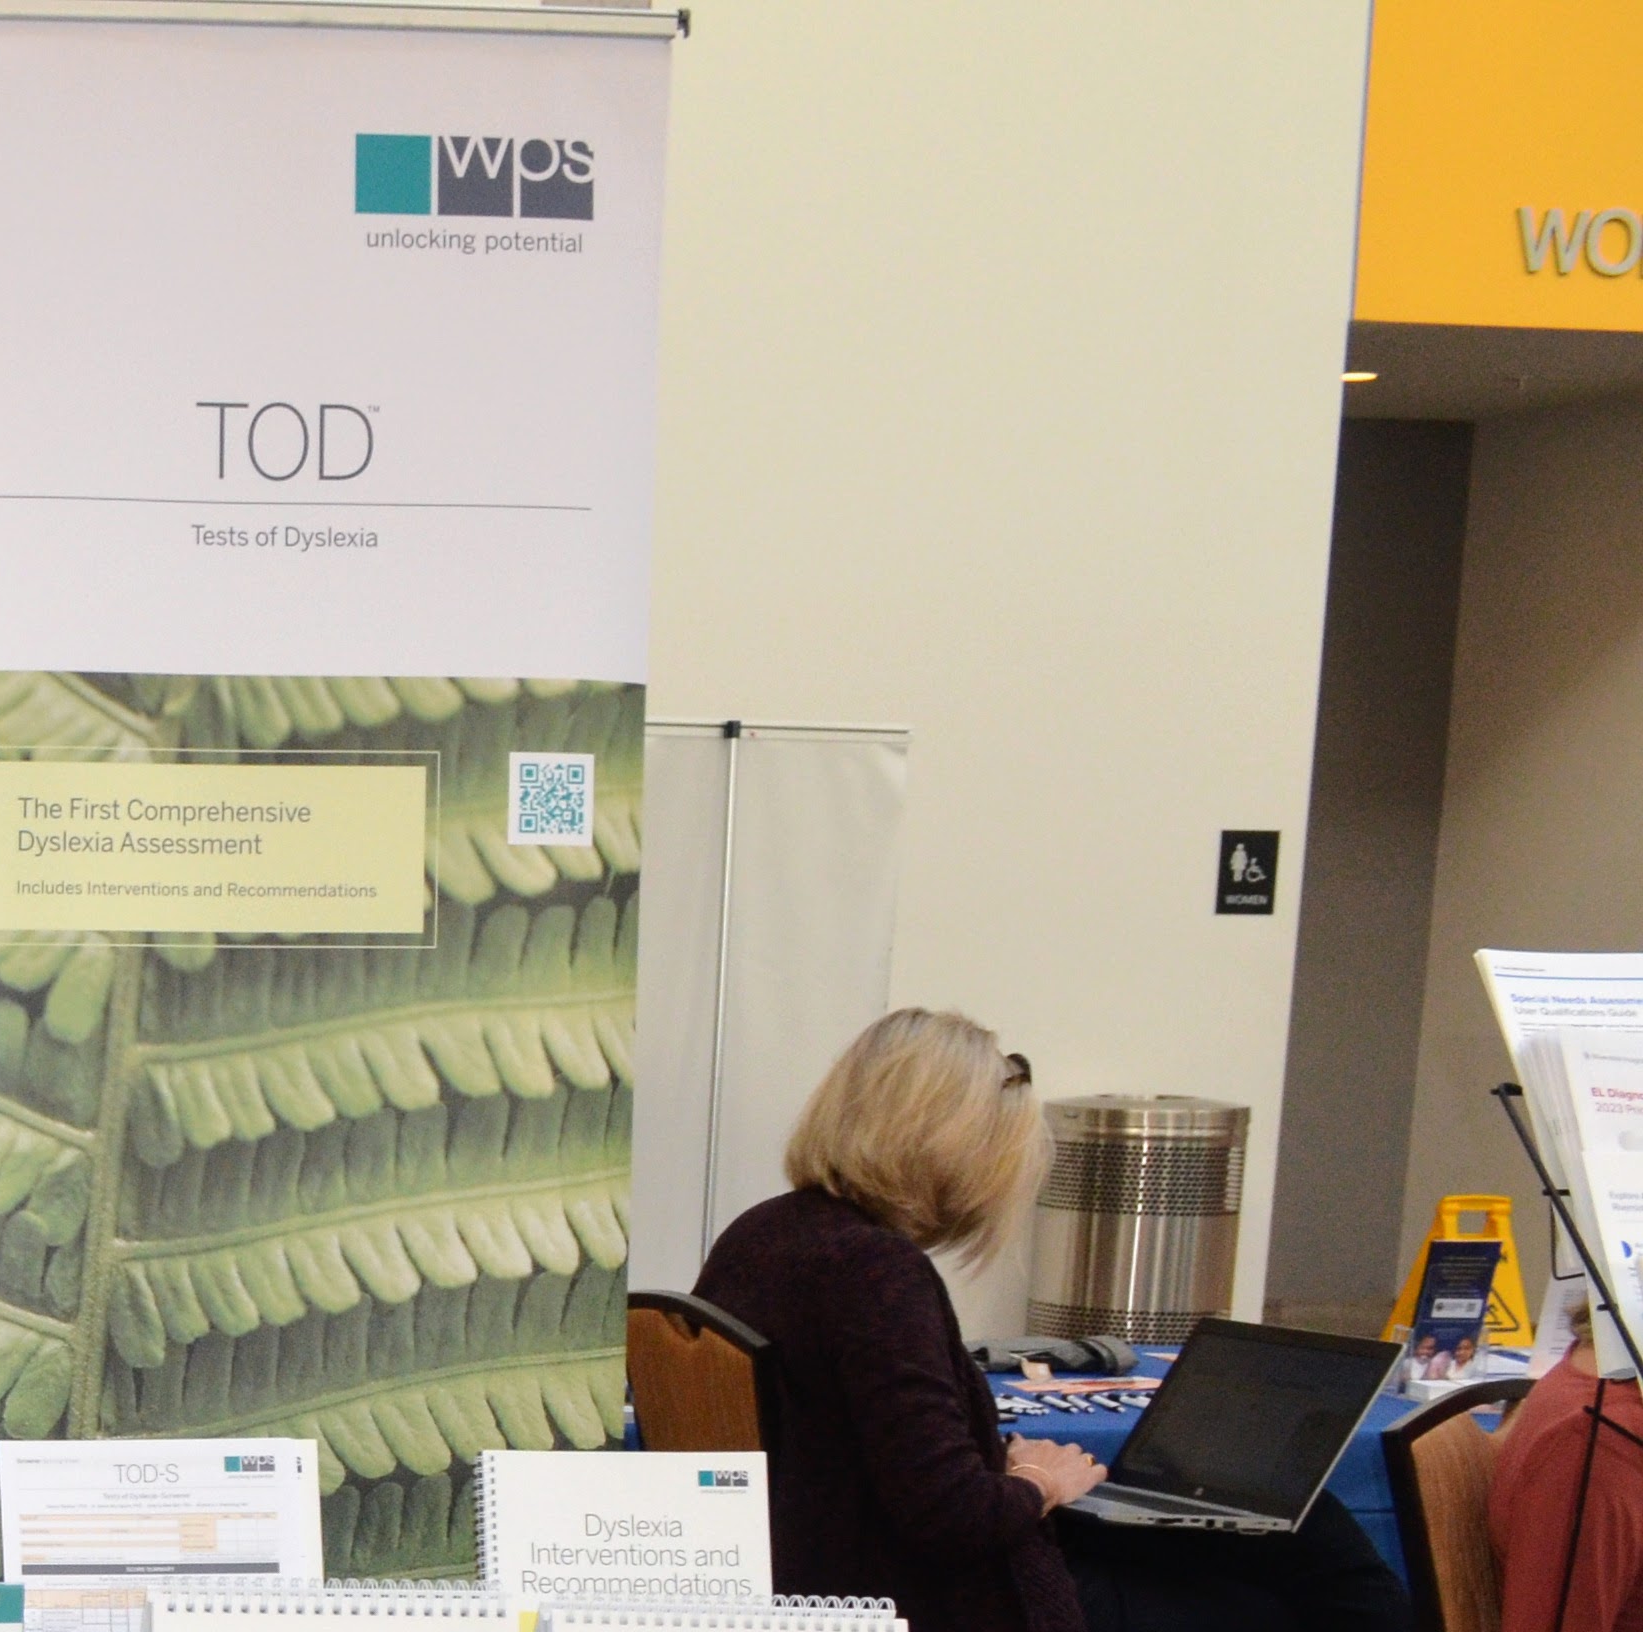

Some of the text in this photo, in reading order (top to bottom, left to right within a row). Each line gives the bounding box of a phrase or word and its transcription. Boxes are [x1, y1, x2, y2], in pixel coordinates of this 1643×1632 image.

[437, 135, 595, 220] wps
[365, 228, 583, 255] unlocking potential
[1518, 206, 1643, 279] WO
[191, 524, 379, 553] Tests of Dyslexia
[16, 797, 312, 829] The First Comprehensive
[16, 831, 263, 859] Dyslexia Assessment
[15, 879, 378, 900] Includes Interventions and Recommendations
[113, 1463, 180, 1484] TOD-S
[584, 1514, 683, 1543] Dyslexia
[531, 1542, 740, 1567] Interventions and
[521, 1570, 753, 1597] Recommendations
